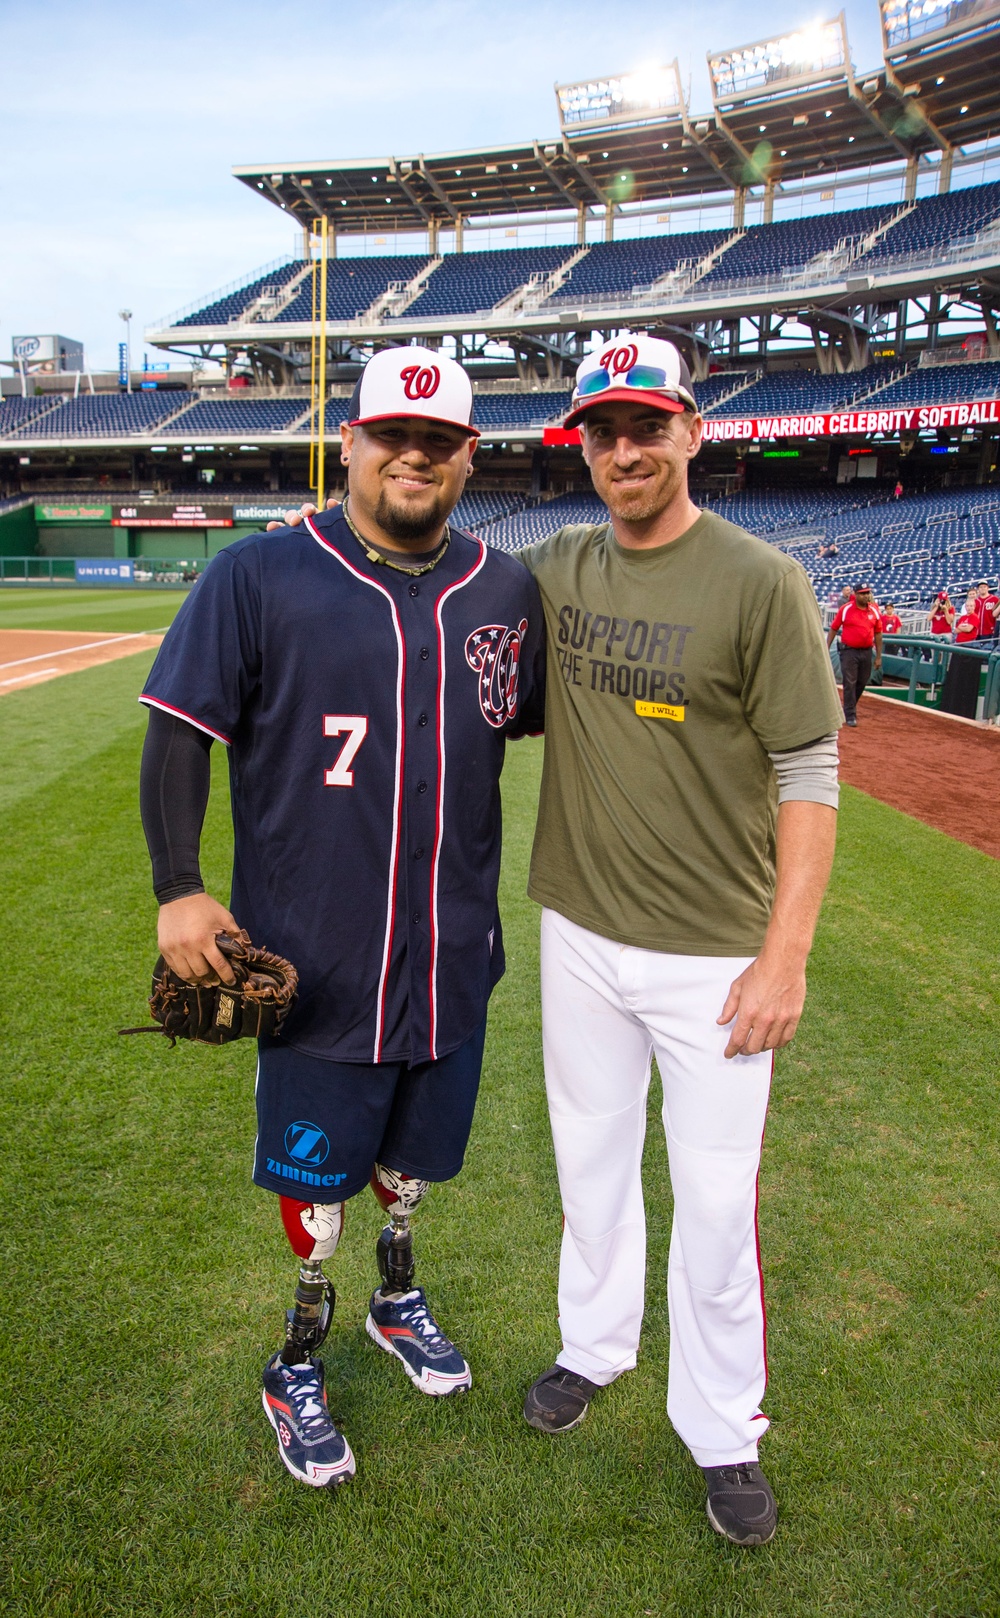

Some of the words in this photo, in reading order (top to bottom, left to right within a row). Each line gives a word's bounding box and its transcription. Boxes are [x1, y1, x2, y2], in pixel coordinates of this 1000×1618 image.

[400, 364, 440, 400] W
[700, 421, 752, 440] UNDED
[757, 416, 825, 438] WARRIOR
[829, 410, 914, 434] CELEBRITY
[918, 402, 999, 428] SOFTBALL
[78, 567, 118, 576] UNITED
[558, 604, 696, 668] SUPPORT
[588, 658, 691, 706] TROOPS.
[322, 713, 369, 787] 7
